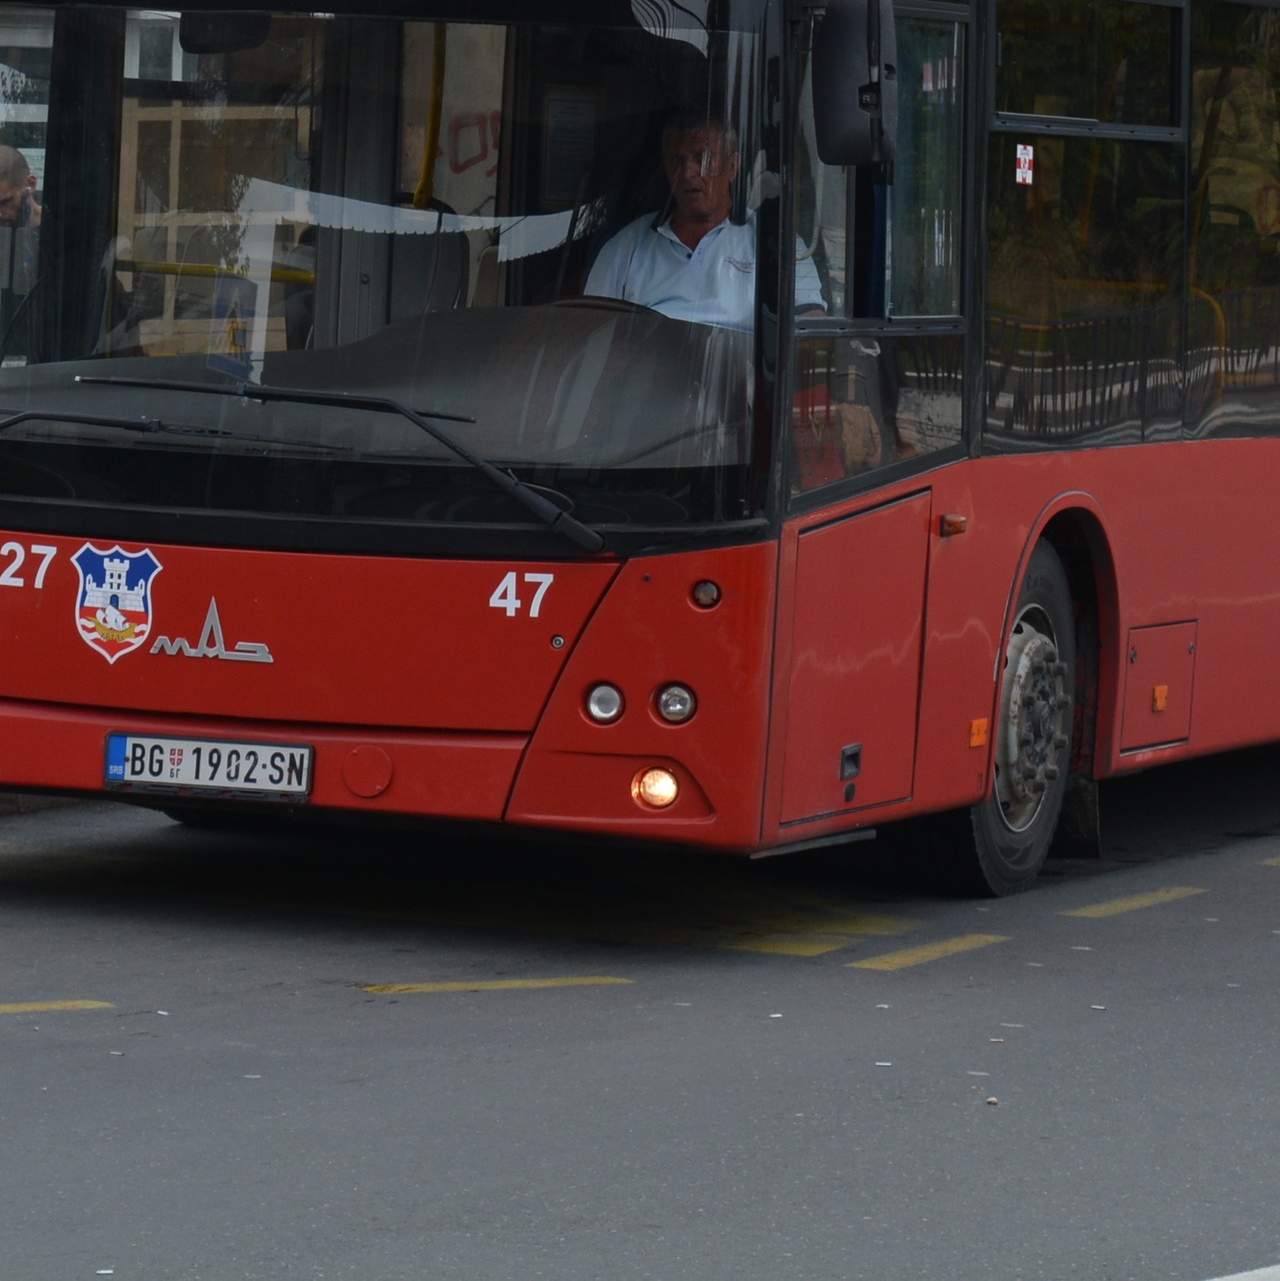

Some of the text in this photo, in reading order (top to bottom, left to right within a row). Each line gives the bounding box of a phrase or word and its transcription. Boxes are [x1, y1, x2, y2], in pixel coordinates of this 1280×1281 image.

[489, 571, 554, 618] 47
[108, 765, 124, 775] SRB
[130, 743, 164, 778] BG
